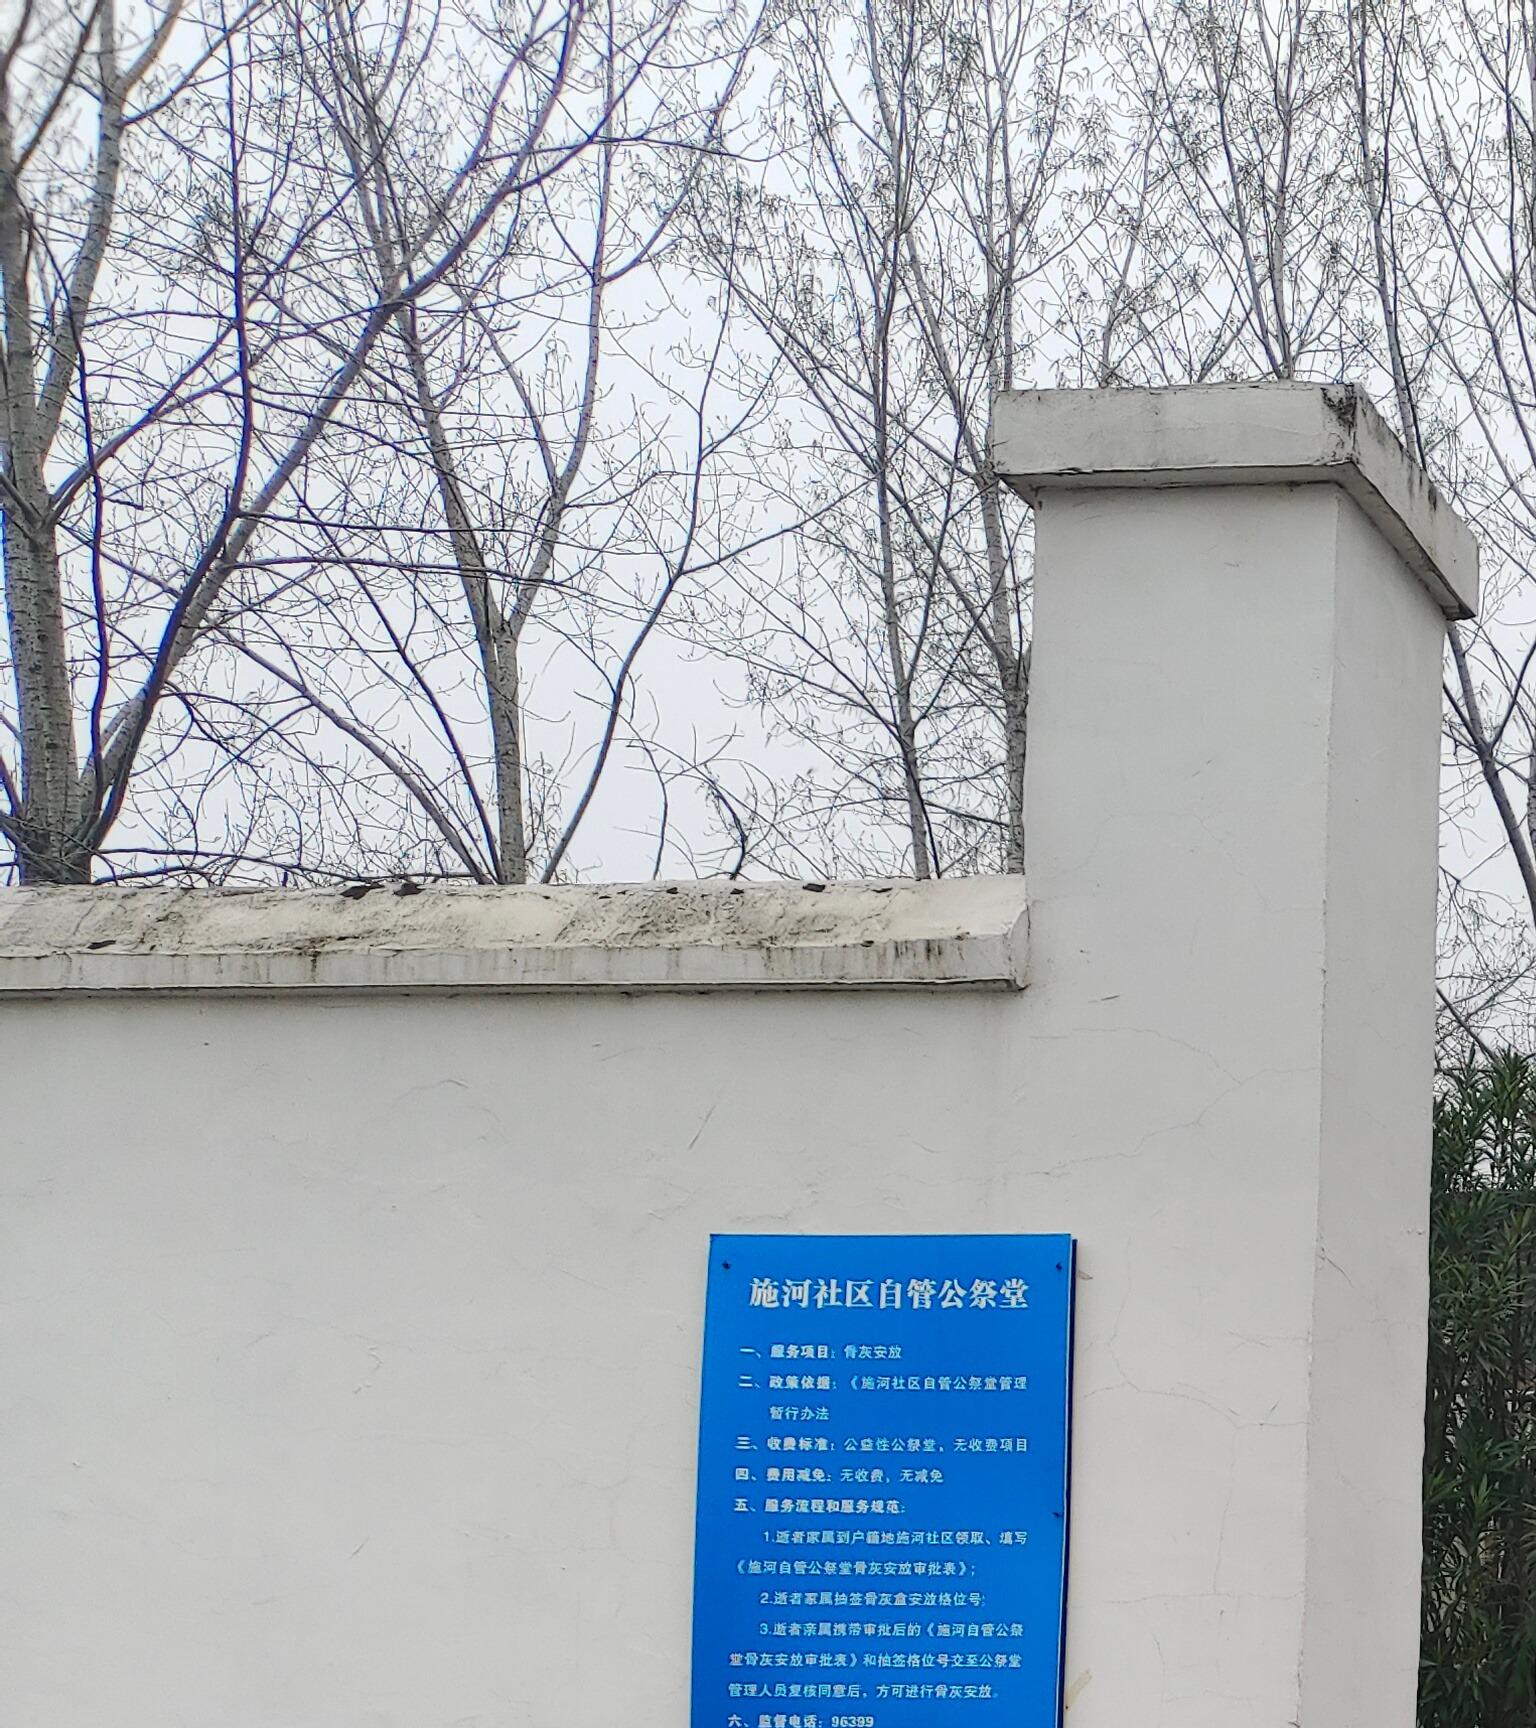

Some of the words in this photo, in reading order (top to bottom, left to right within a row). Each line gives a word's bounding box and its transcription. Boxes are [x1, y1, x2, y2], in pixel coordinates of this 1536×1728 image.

[749, 1277, 1029, 1310] 施河社区自管公祭堂
[769, 1405, 831, 1421] 暂行办法
